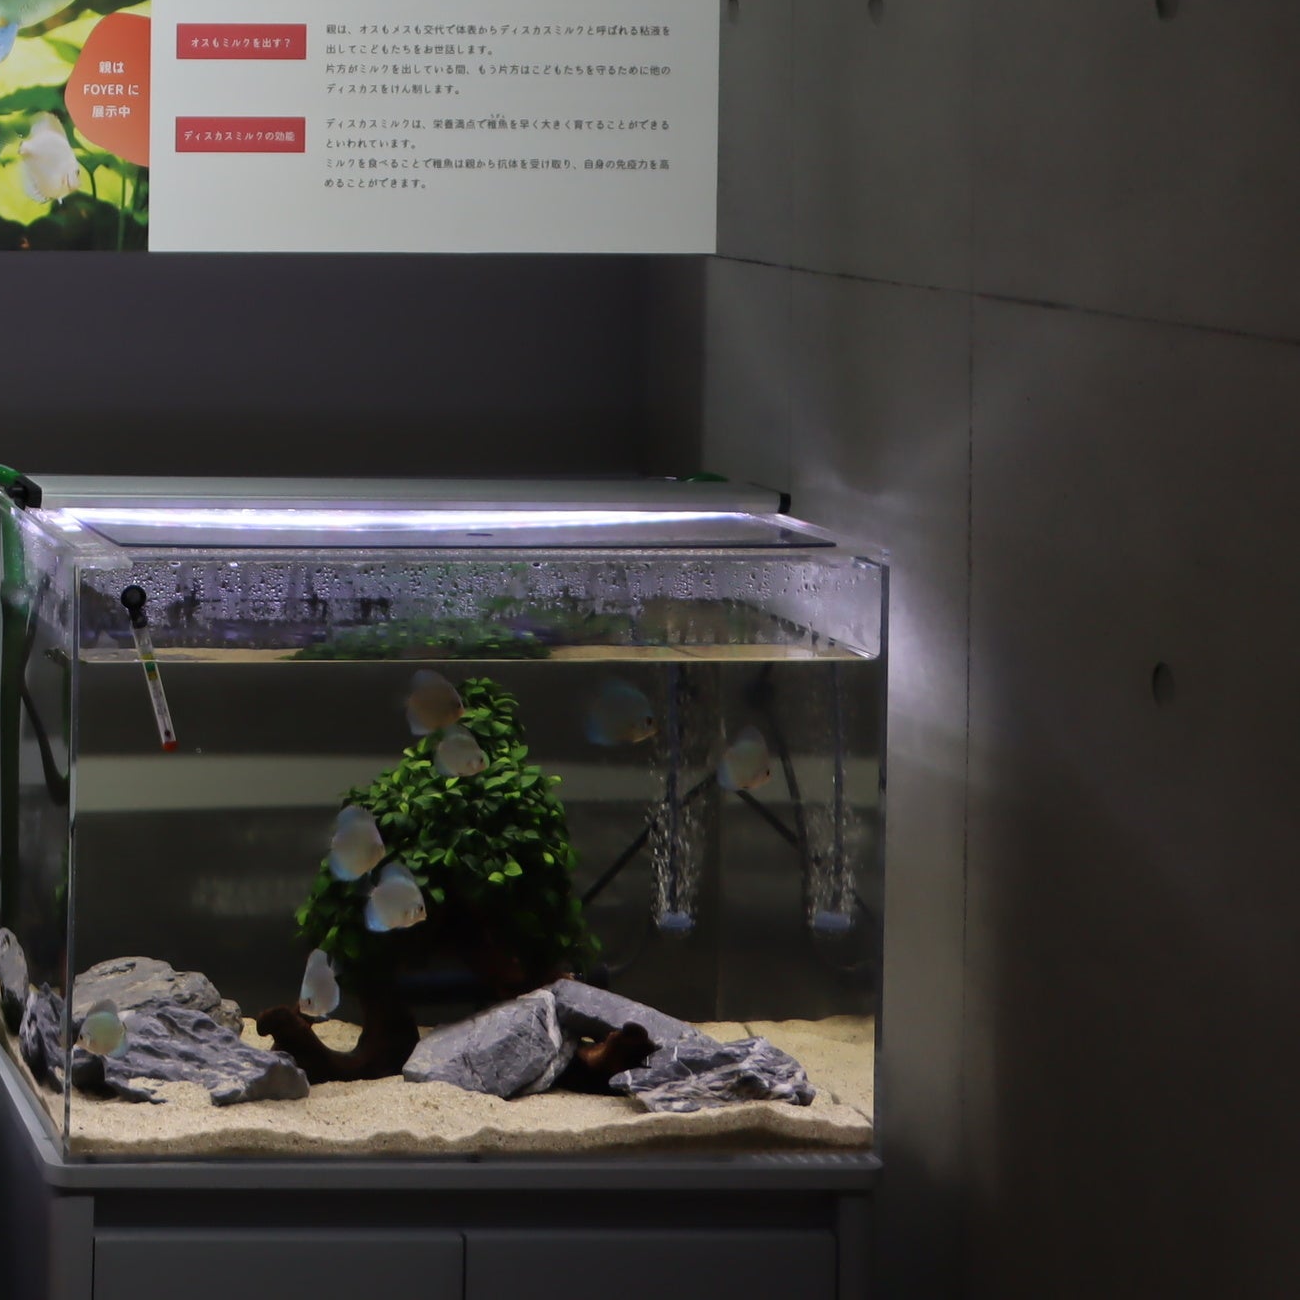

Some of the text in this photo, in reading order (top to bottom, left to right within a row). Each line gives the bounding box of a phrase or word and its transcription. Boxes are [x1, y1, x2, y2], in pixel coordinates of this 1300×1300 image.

[99, 60, 124, 74] 親は
[83, 83, 139, 96] FOYER に
[325, 83, 460, 95] ディスカスをけん制します。
[92, 104, 131, 118] 展示中
[184, 130, 296, 142] ディスカスミルクの効能
[325, 138, 416, 150] といわれています。
[324, 177, 427, 189] めることができます。
